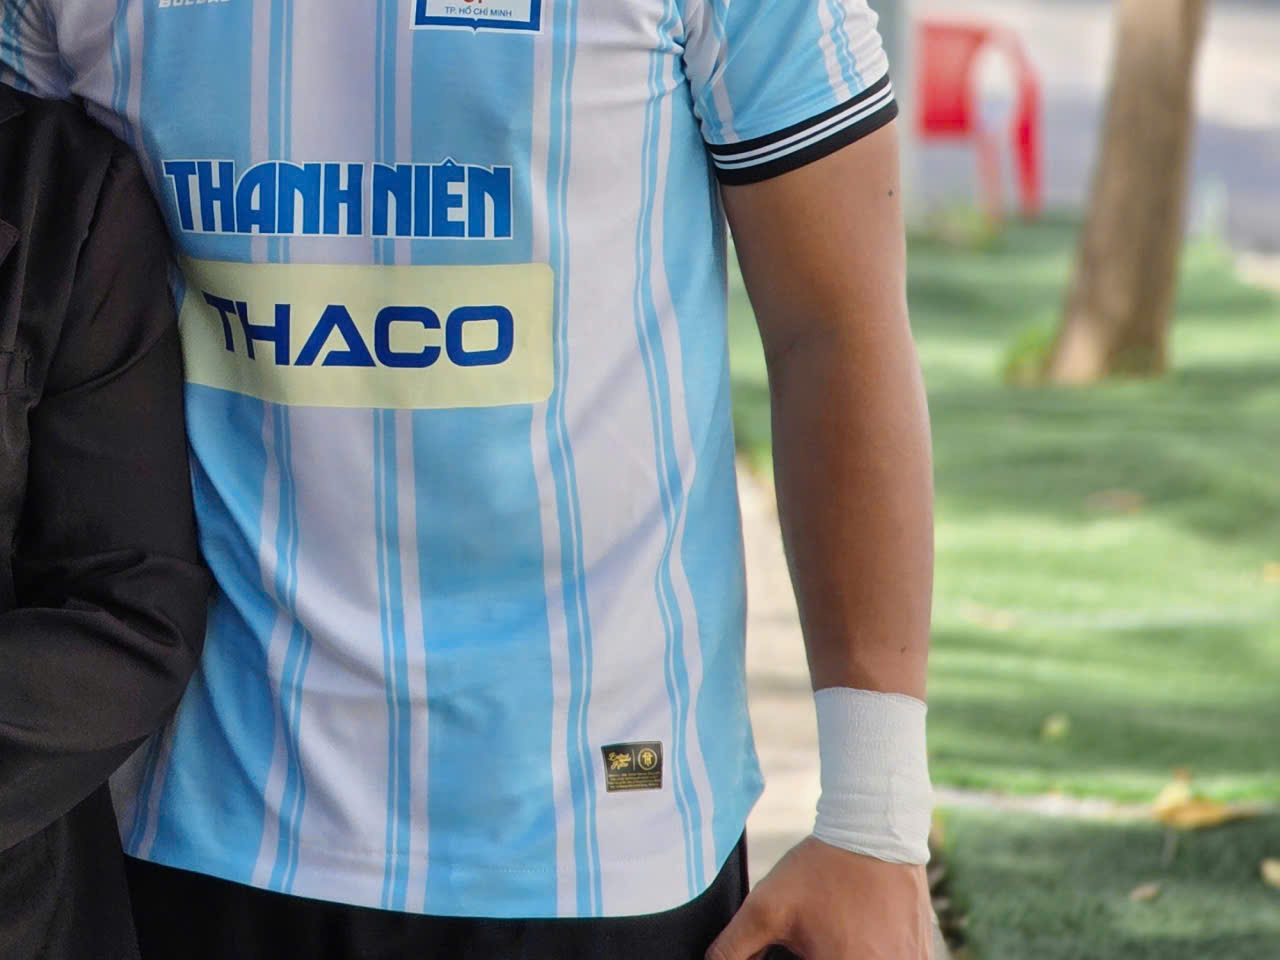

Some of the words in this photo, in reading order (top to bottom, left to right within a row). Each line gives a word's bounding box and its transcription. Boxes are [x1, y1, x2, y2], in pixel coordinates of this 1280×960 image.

[490, 8, 512, 17] MINH
[161, 159, 365, 237] THANH
[370, 156, 514, 240] NIÊN
[201, 290, 515, 369] THACO
